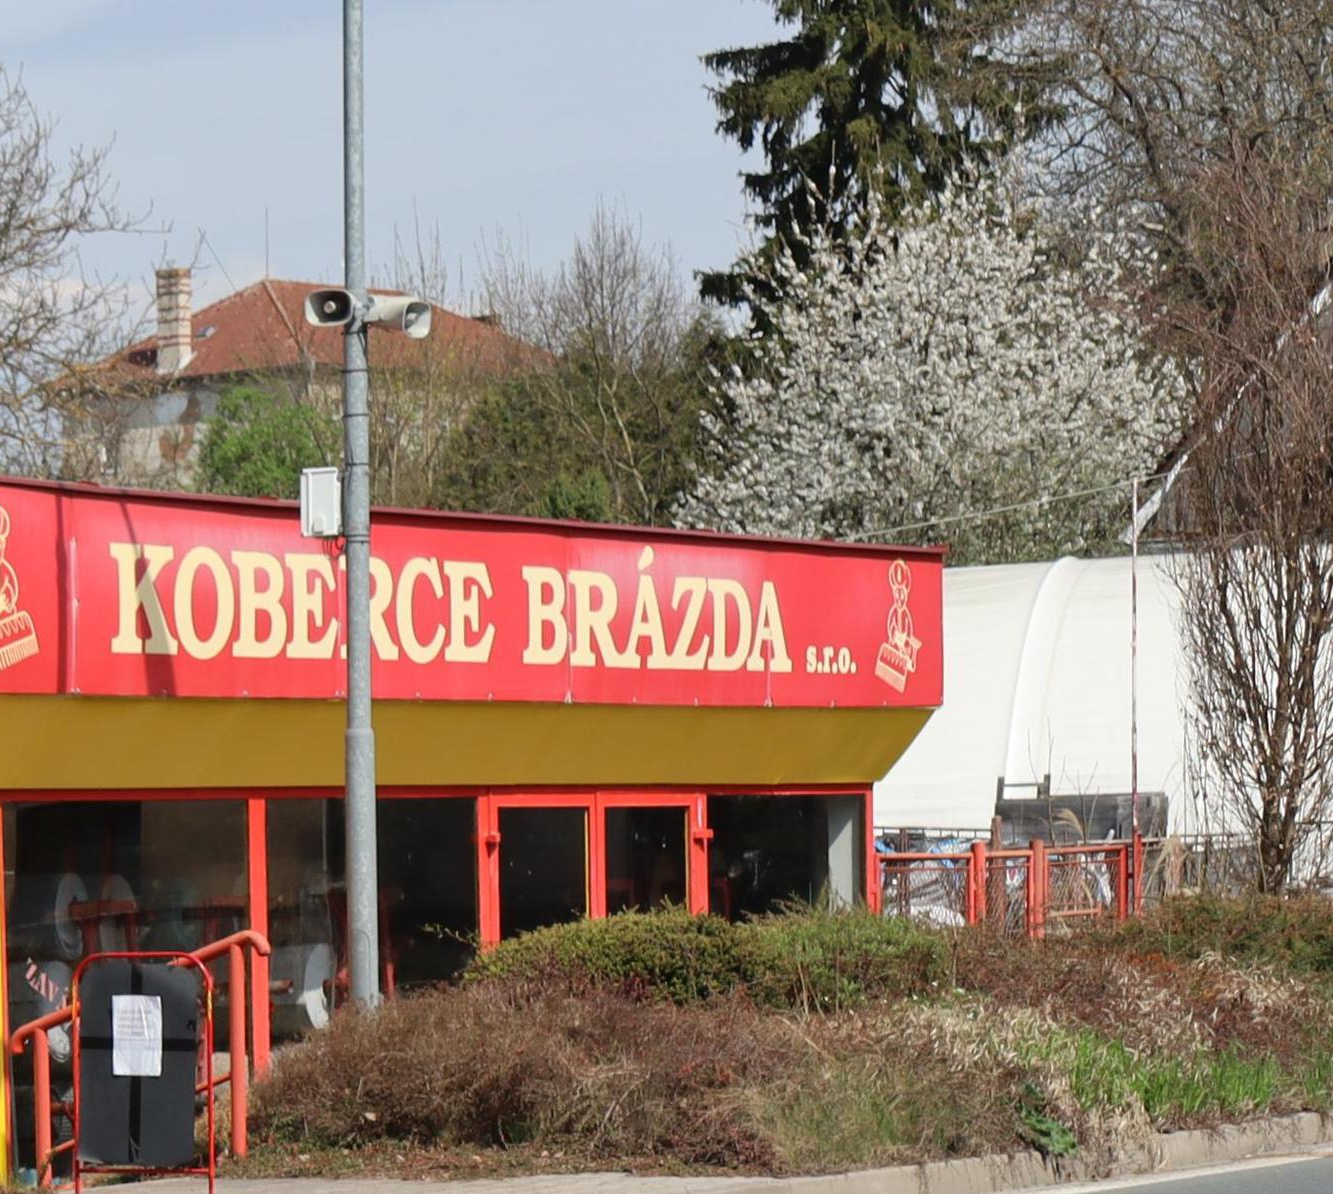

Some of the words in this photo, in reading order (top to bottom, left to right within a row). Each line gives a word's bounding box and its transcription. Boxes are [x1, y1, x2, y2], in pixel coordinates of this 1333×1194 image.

[108, 541, 497, 665] KOBERCE
[521, 545, 794, 674] BRÁZDA
[805, 645, 858, 675] s.r.o.
